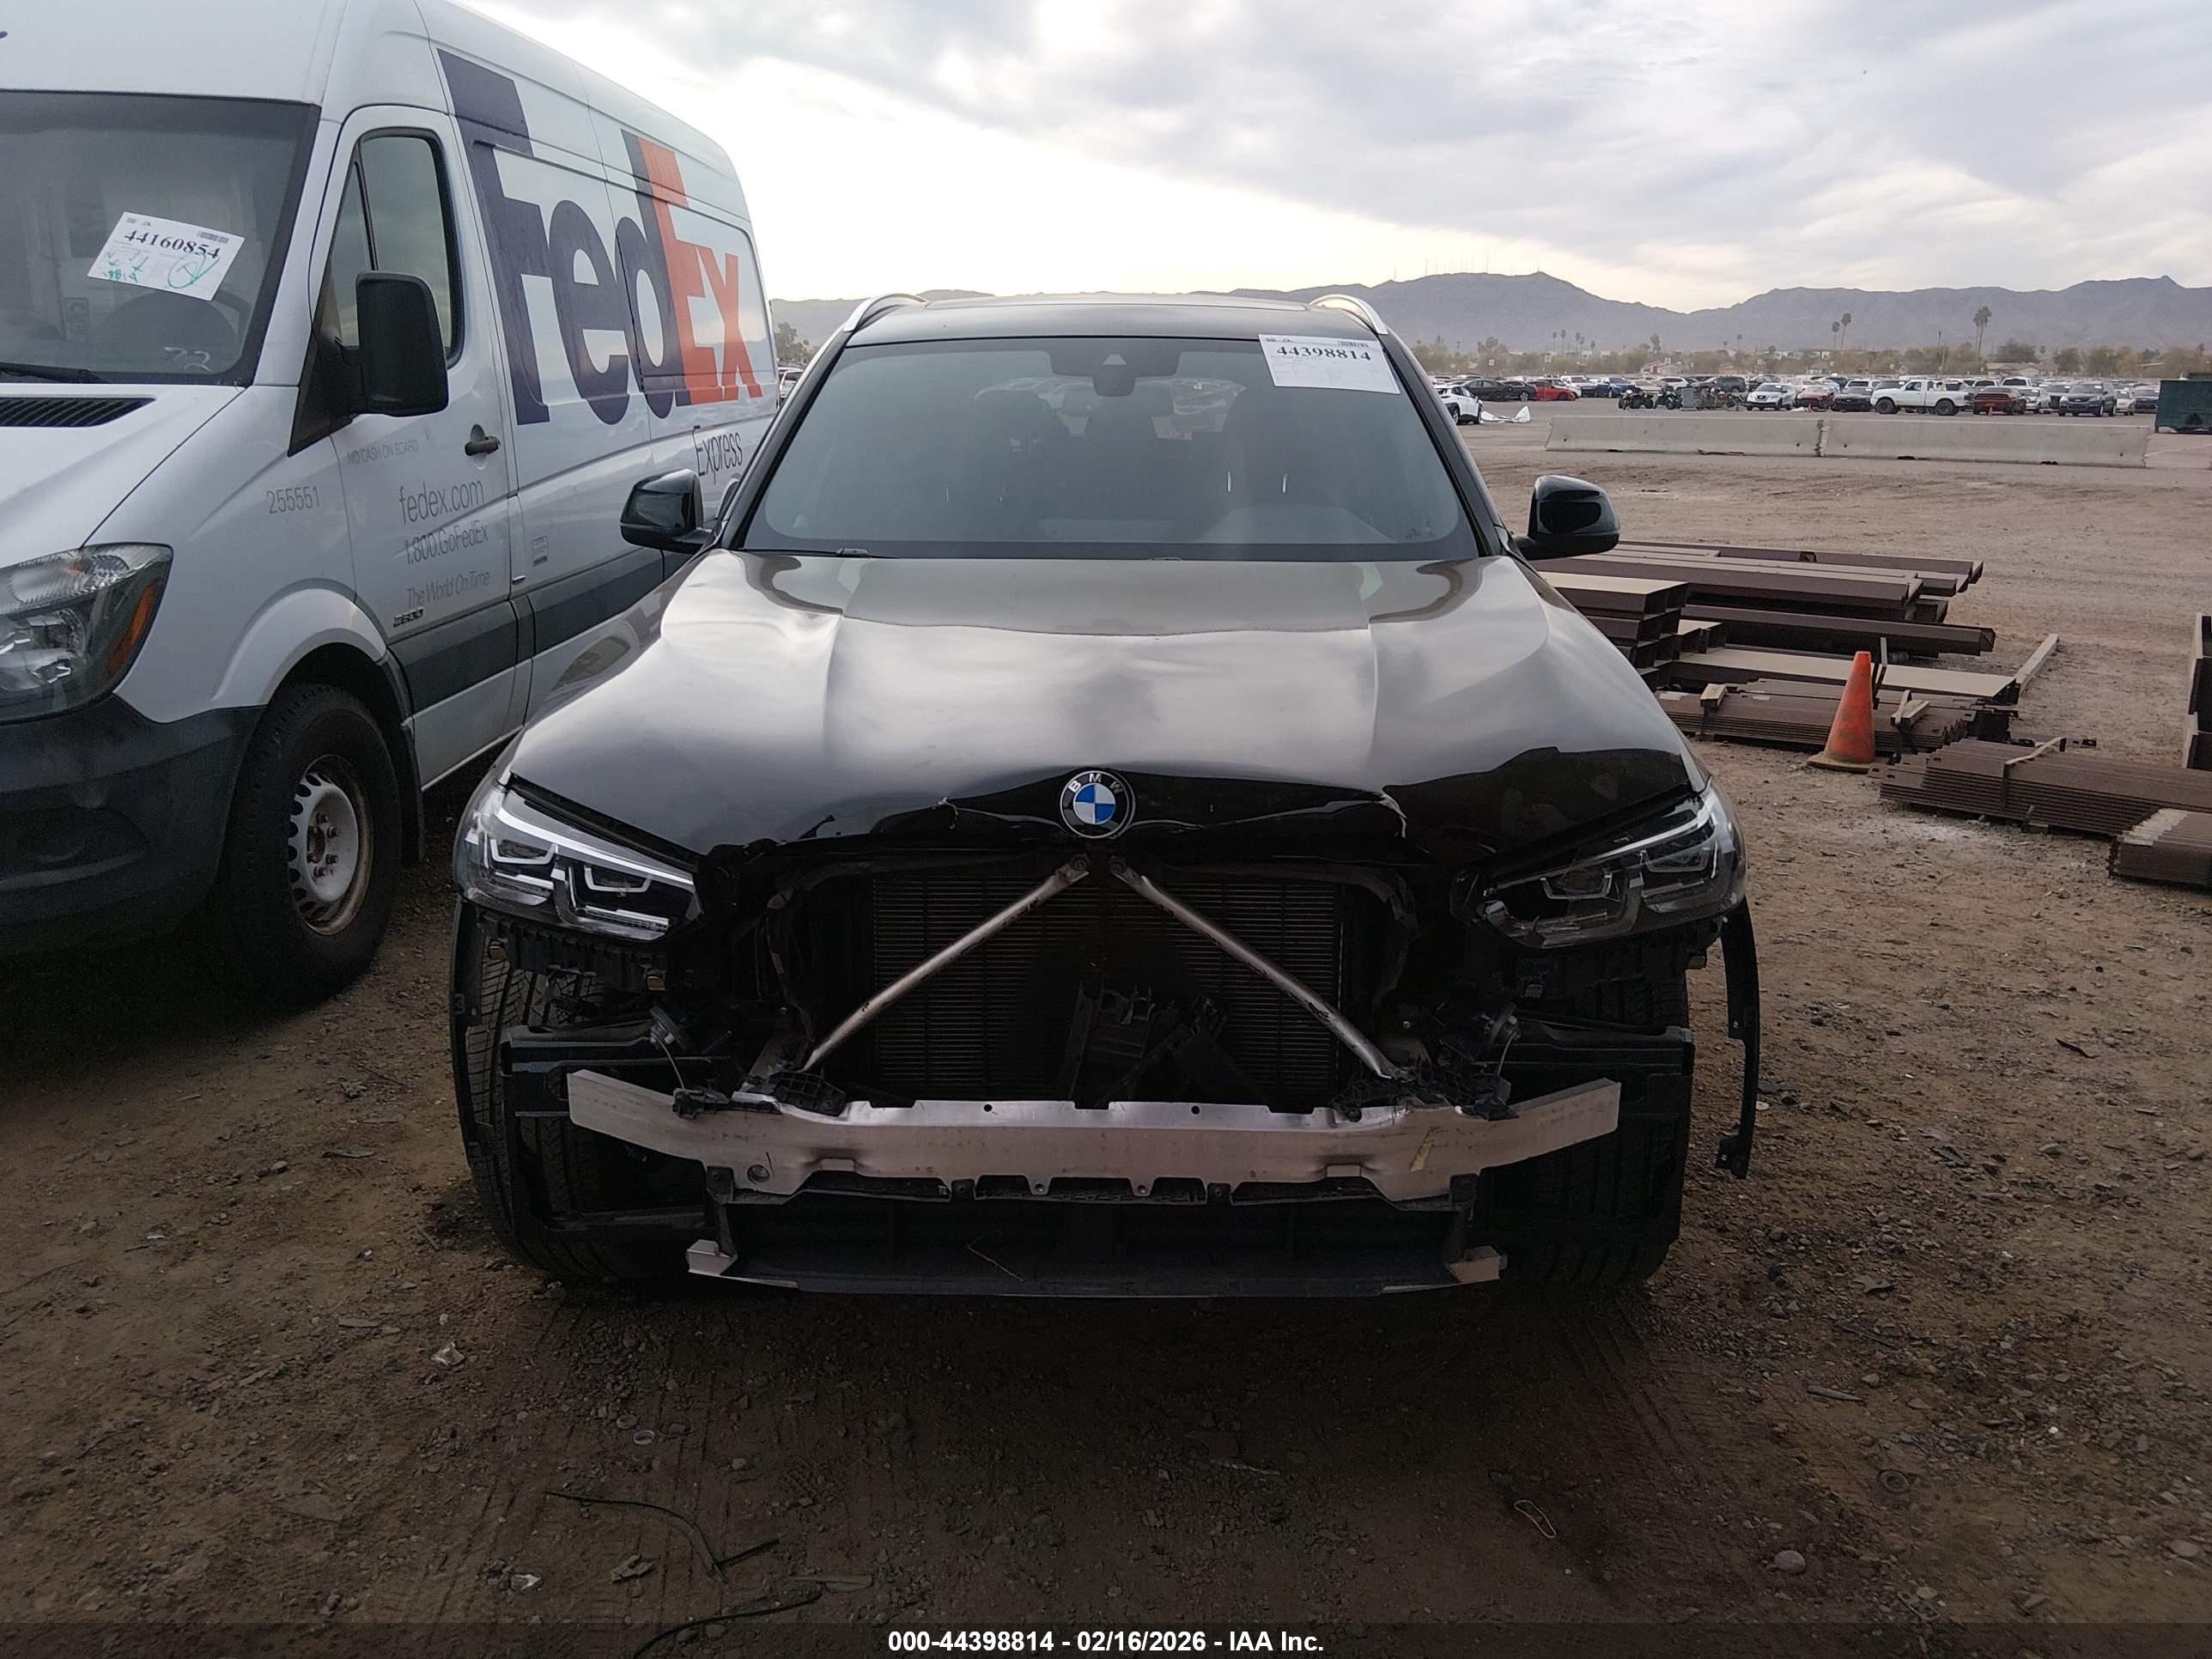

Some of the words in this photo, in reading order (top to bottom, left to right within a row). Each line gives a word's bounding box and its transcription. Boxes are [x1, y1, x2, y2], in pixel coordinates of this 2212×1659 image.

[124, 229, 221, 259] 44160854
[436, 47, 763, 426] FedEx
[1276, 345, 1371, 362] 44398814
[361, 446, 382, 463] CASH
[692, 424, 743, 485] Express
[265, 485, 321, 514] 255551
[399, 479, 485, 524] fedex.com
[404, 520, 489, 565] 1.800.GoFedEx
[407, 586, 425, 609] The
[426, 576, 453, 604] World
[455, 573, 469, 595] On
[469, 569, 490, 592] Time
[1067, 773, 1123, 795] BMW
